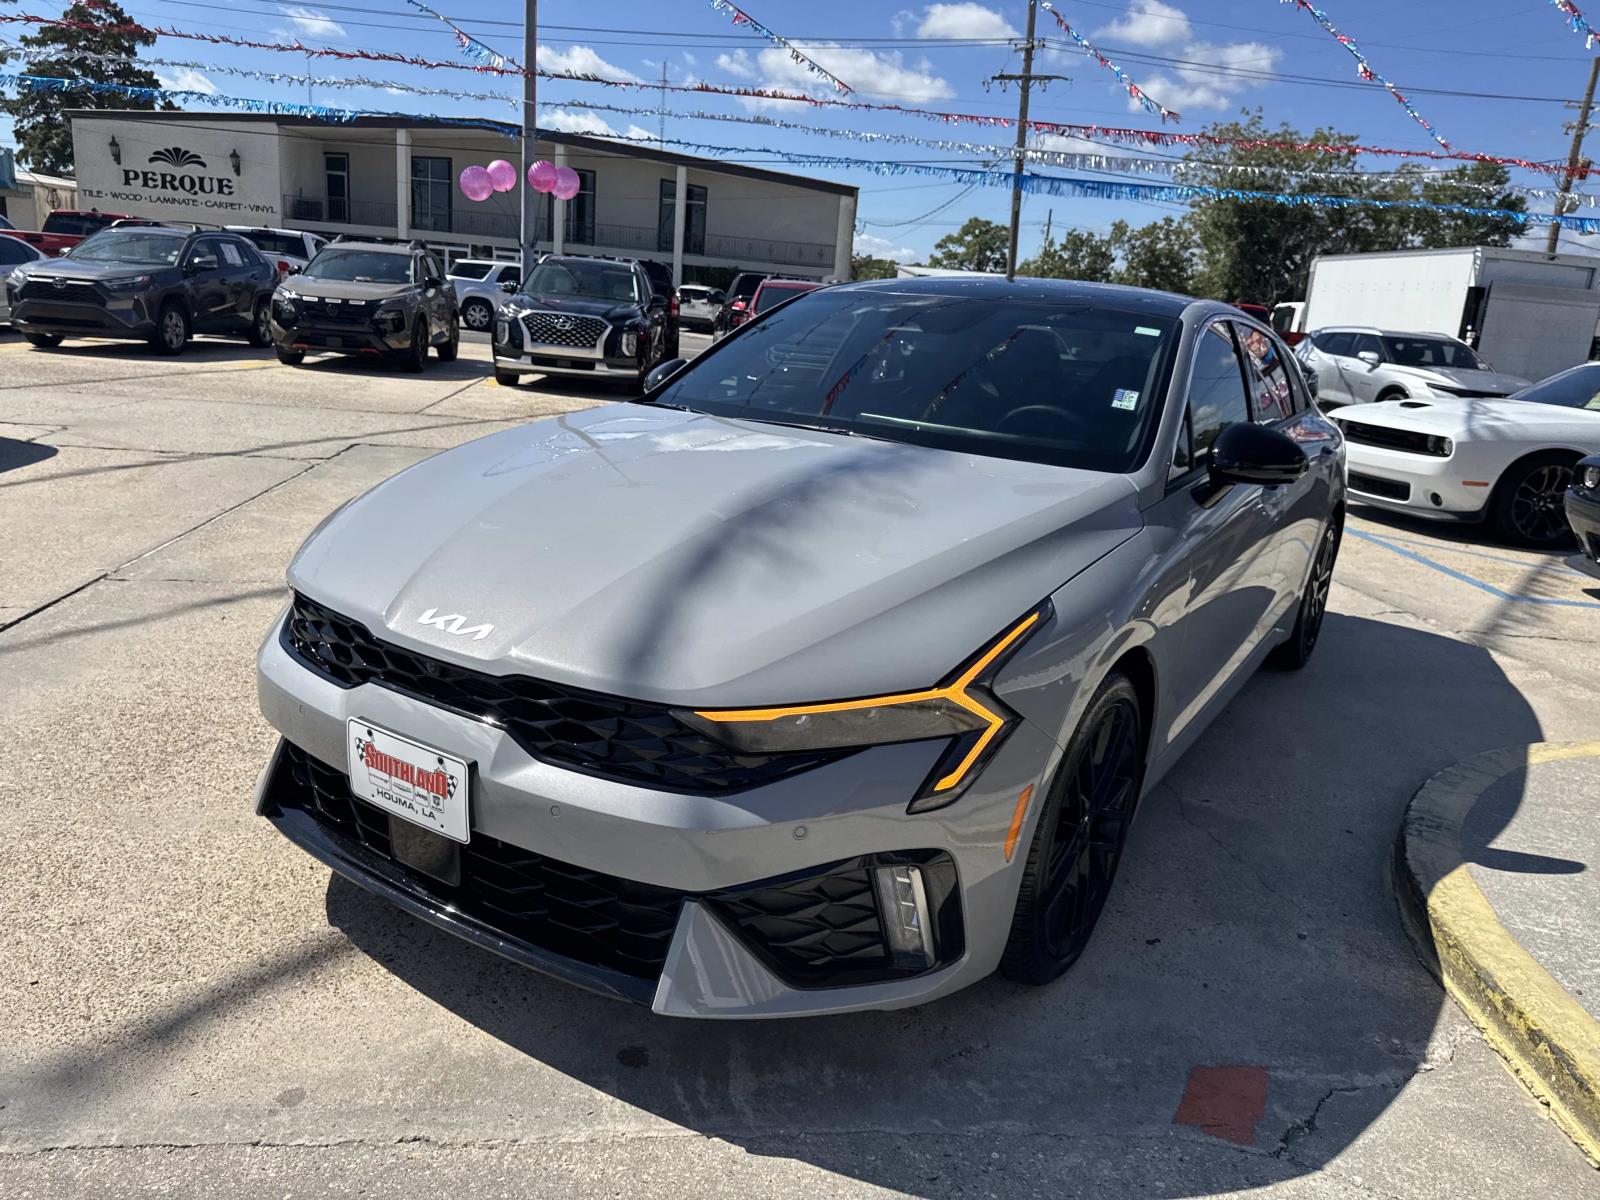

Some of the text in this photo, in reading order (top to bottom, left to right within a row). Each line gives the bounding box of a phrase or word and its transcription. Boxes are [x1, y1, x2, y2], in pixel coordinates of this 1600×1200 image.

[123, 169, 234, 195] PERQUE
[82, 189, 277, 213] TILE WOOD LAMINATE CARPET VINYL
[417, 608, 495, 641] KIA
[365, 743, 448, 800] SOUTHLAND
[376, 788, 436, 820] HOUMA, LA
